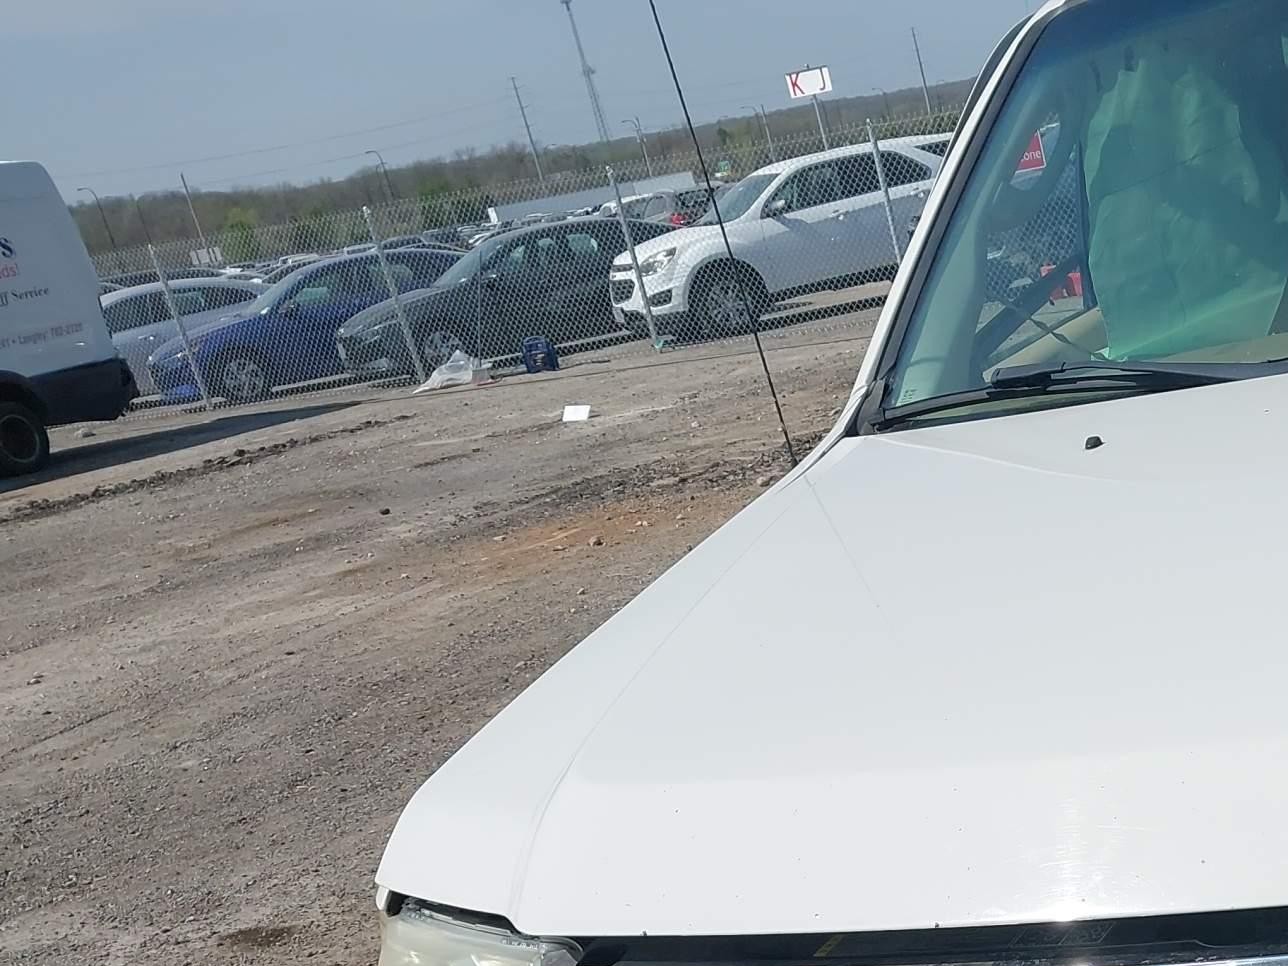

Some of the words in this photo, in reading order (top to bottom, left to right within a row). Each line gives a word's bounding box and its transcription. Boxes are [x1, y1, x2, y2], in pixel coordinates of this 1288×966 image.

[788, 72, 805, 97] K
[818, 67, 826, 91] J
[11, 286, 49, 300] Service
